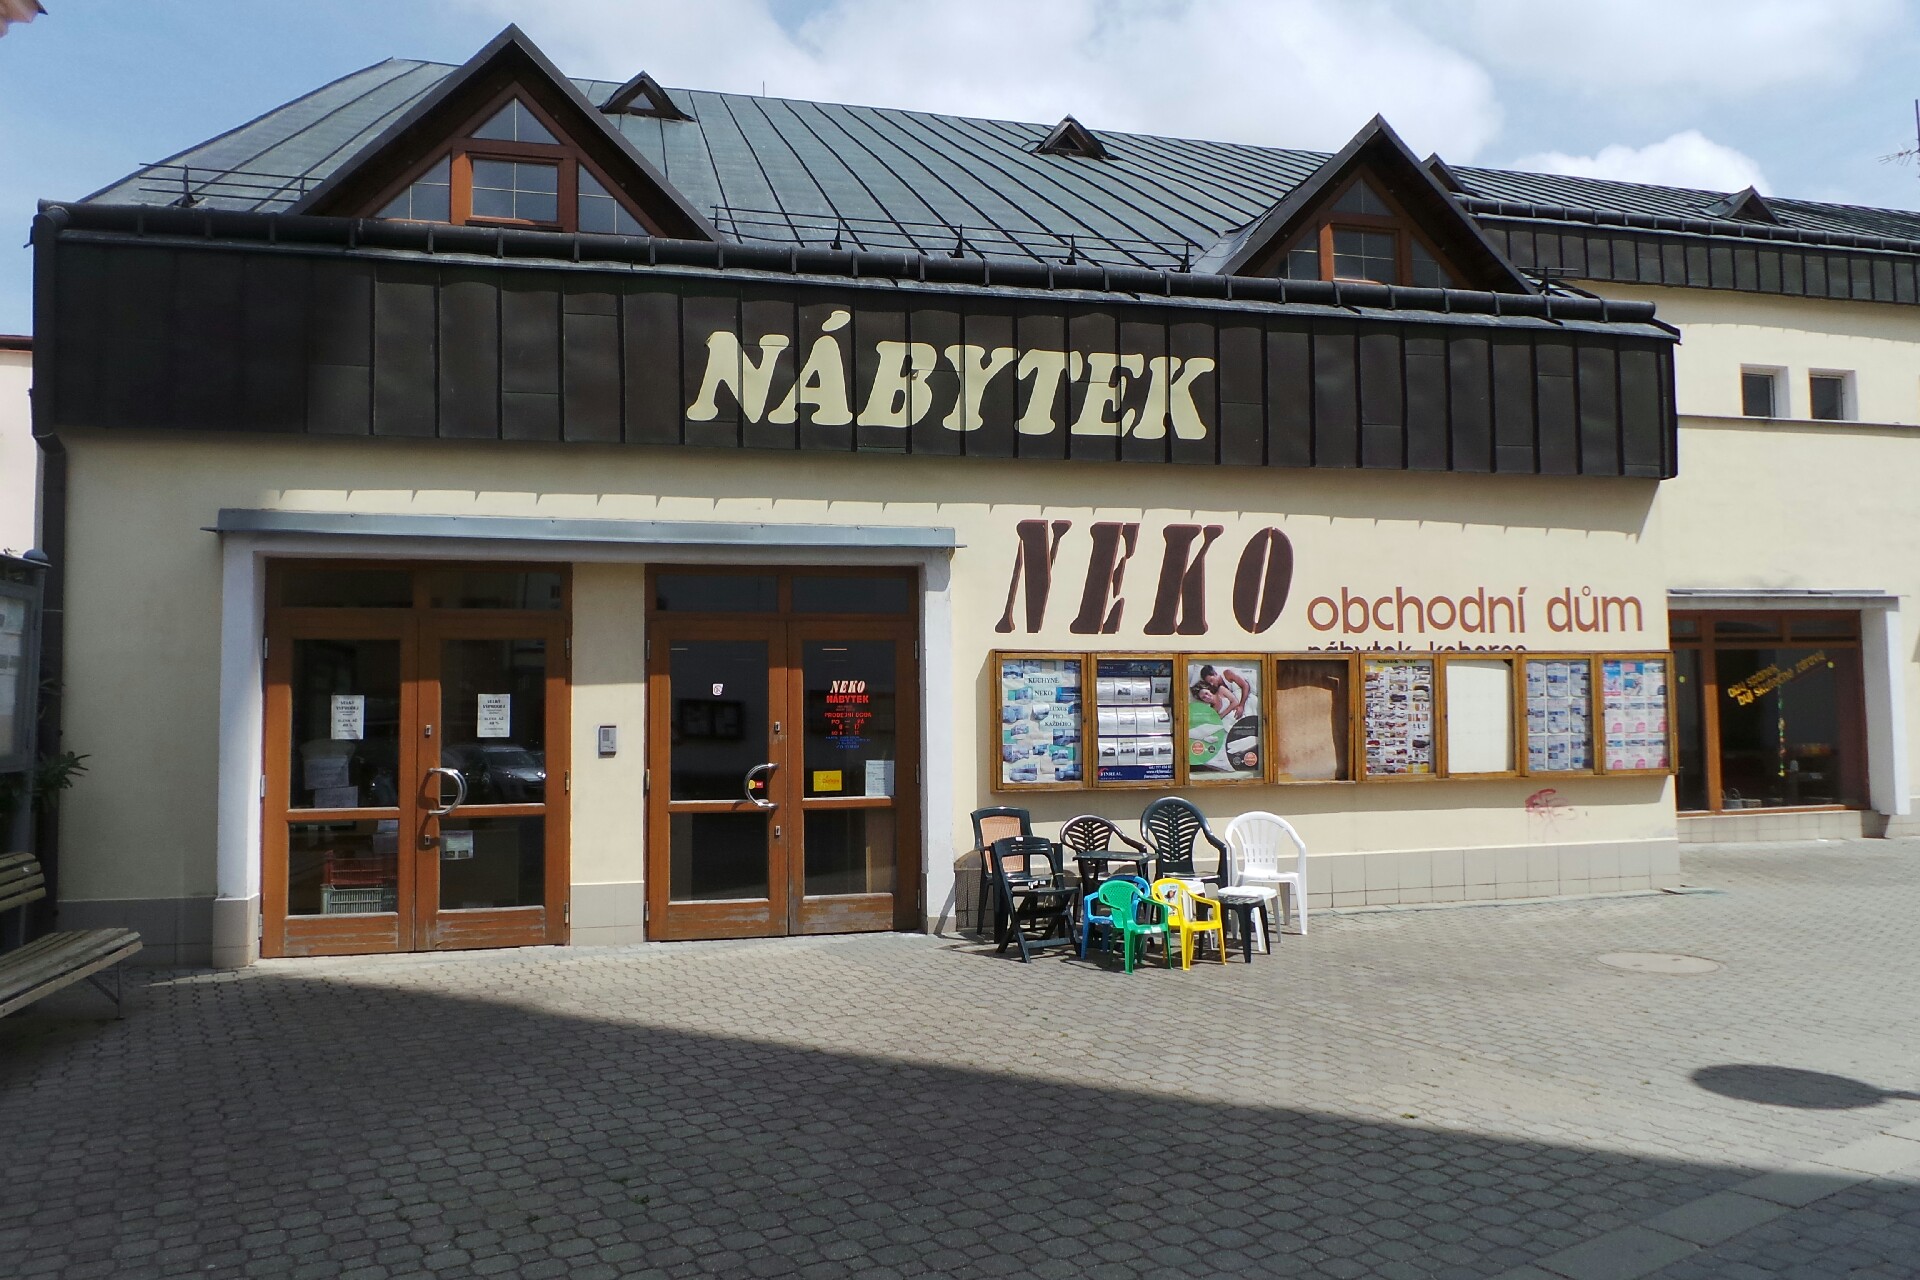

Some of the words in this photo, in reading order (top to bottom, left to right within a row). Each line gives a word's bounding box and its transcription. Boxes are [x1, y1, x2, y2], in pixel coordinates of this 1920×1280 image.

[687, 310, 1216, 440] NÁBYTEK
[994, 518, 1294, 635] NEKO
[1307, 586, 1527, 634] obchodní
[1546, 585, 1643, 632] dům
[830, 680, 866, 694] NEKO
